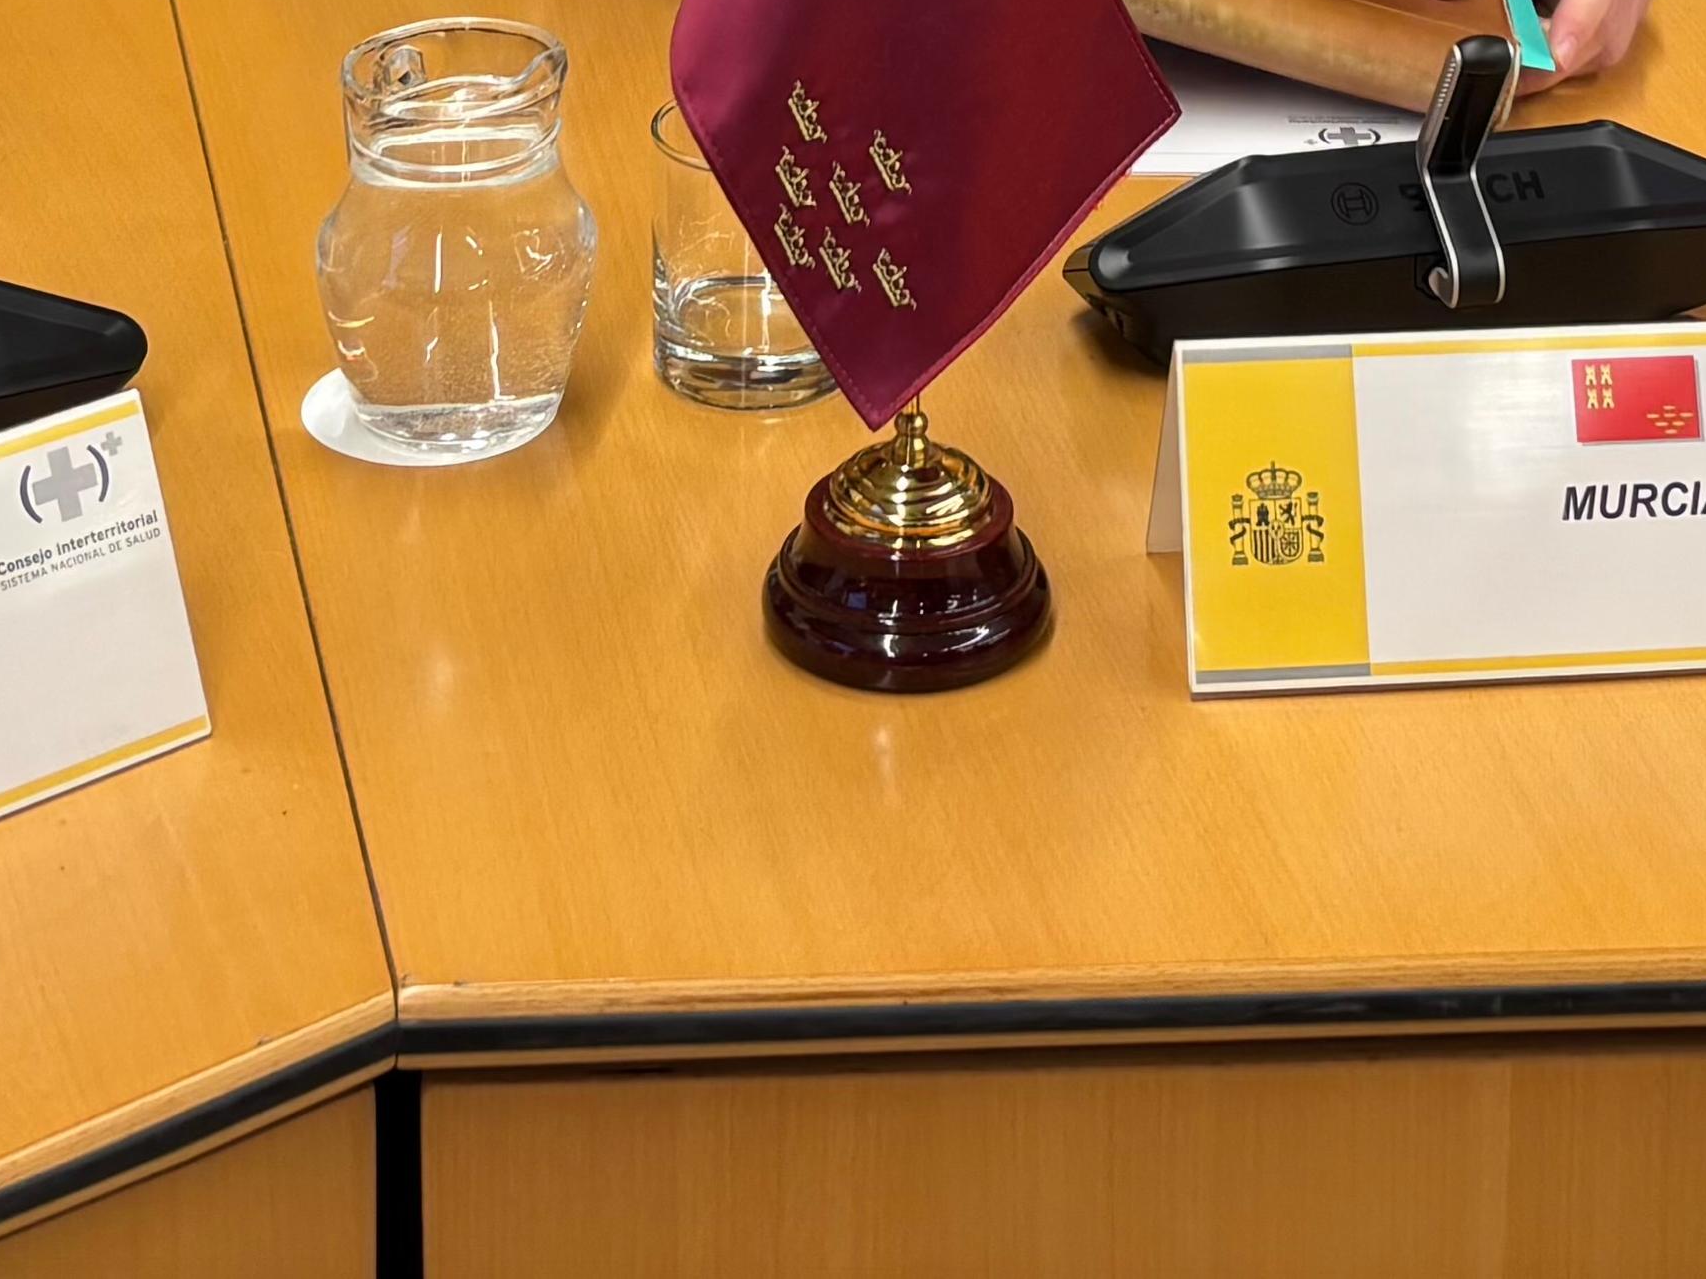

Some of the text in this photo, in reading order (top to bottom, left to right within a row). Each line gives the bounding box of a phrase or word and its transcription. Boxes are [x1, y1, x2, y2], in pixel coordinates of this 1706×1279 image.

[0, 527, 162, 592] SISTEMA NACIONAL DE SALUD
[56, 509, 159, 556] Interterritorial
